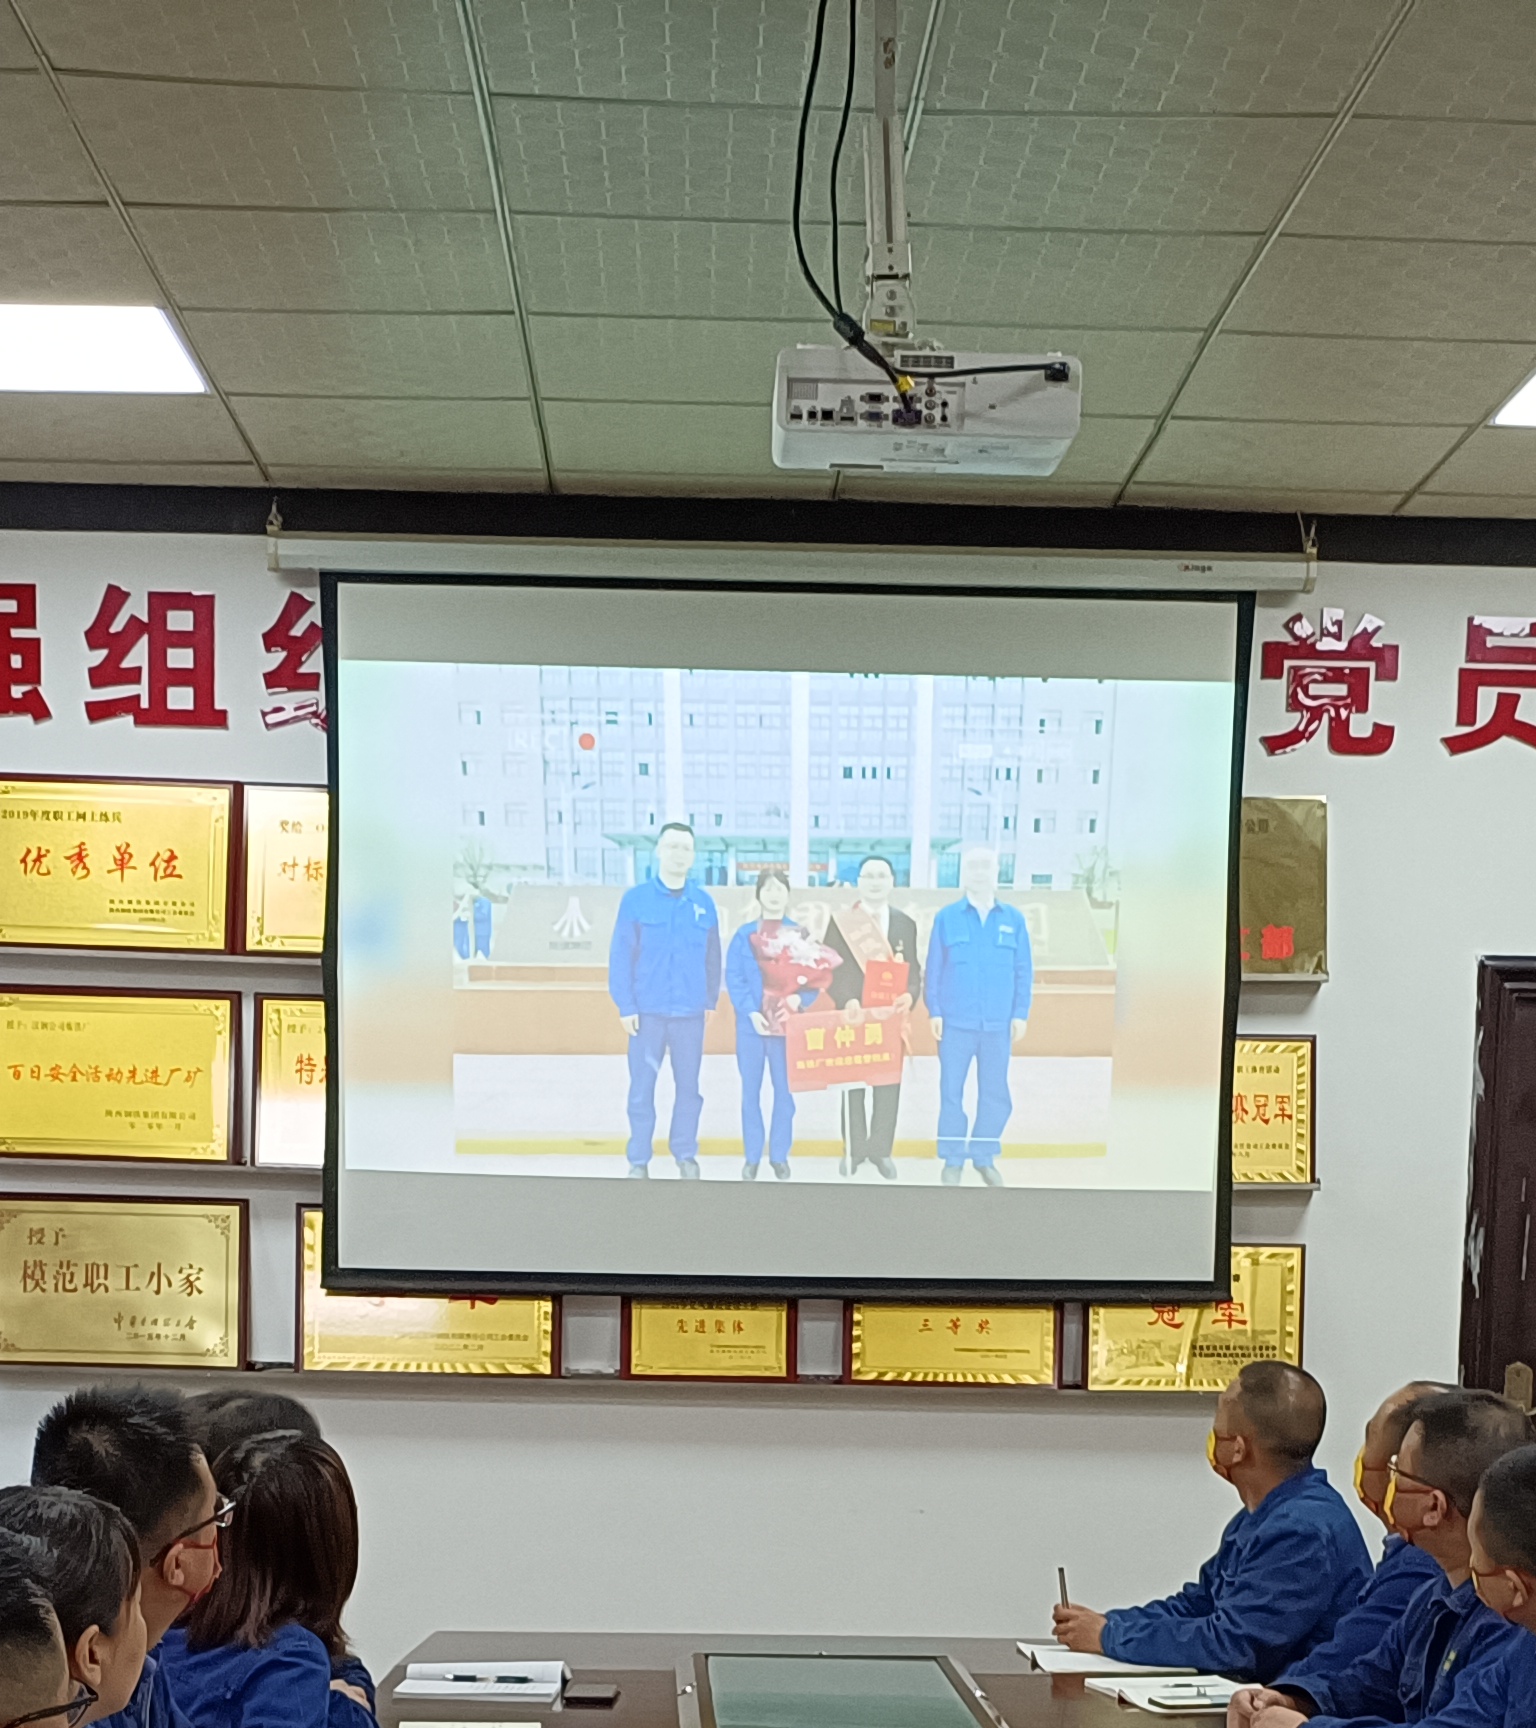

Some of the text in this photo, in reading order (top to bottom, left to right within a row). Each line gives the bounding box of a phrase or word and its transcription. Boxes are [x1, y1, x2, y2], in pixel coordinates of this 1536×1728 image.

[19, 840, 184, 882] 优秀单位
[6, 1063, 205, 1089] 百日安全活动先进厂矿
[27, 1227, 67, 1246] 授予
[19, 1259, 204, 1297] 模范职工小家
[676, 1318, 745, 1335] 先进集体
[918, 1317, 992, 1336] 三等奖
